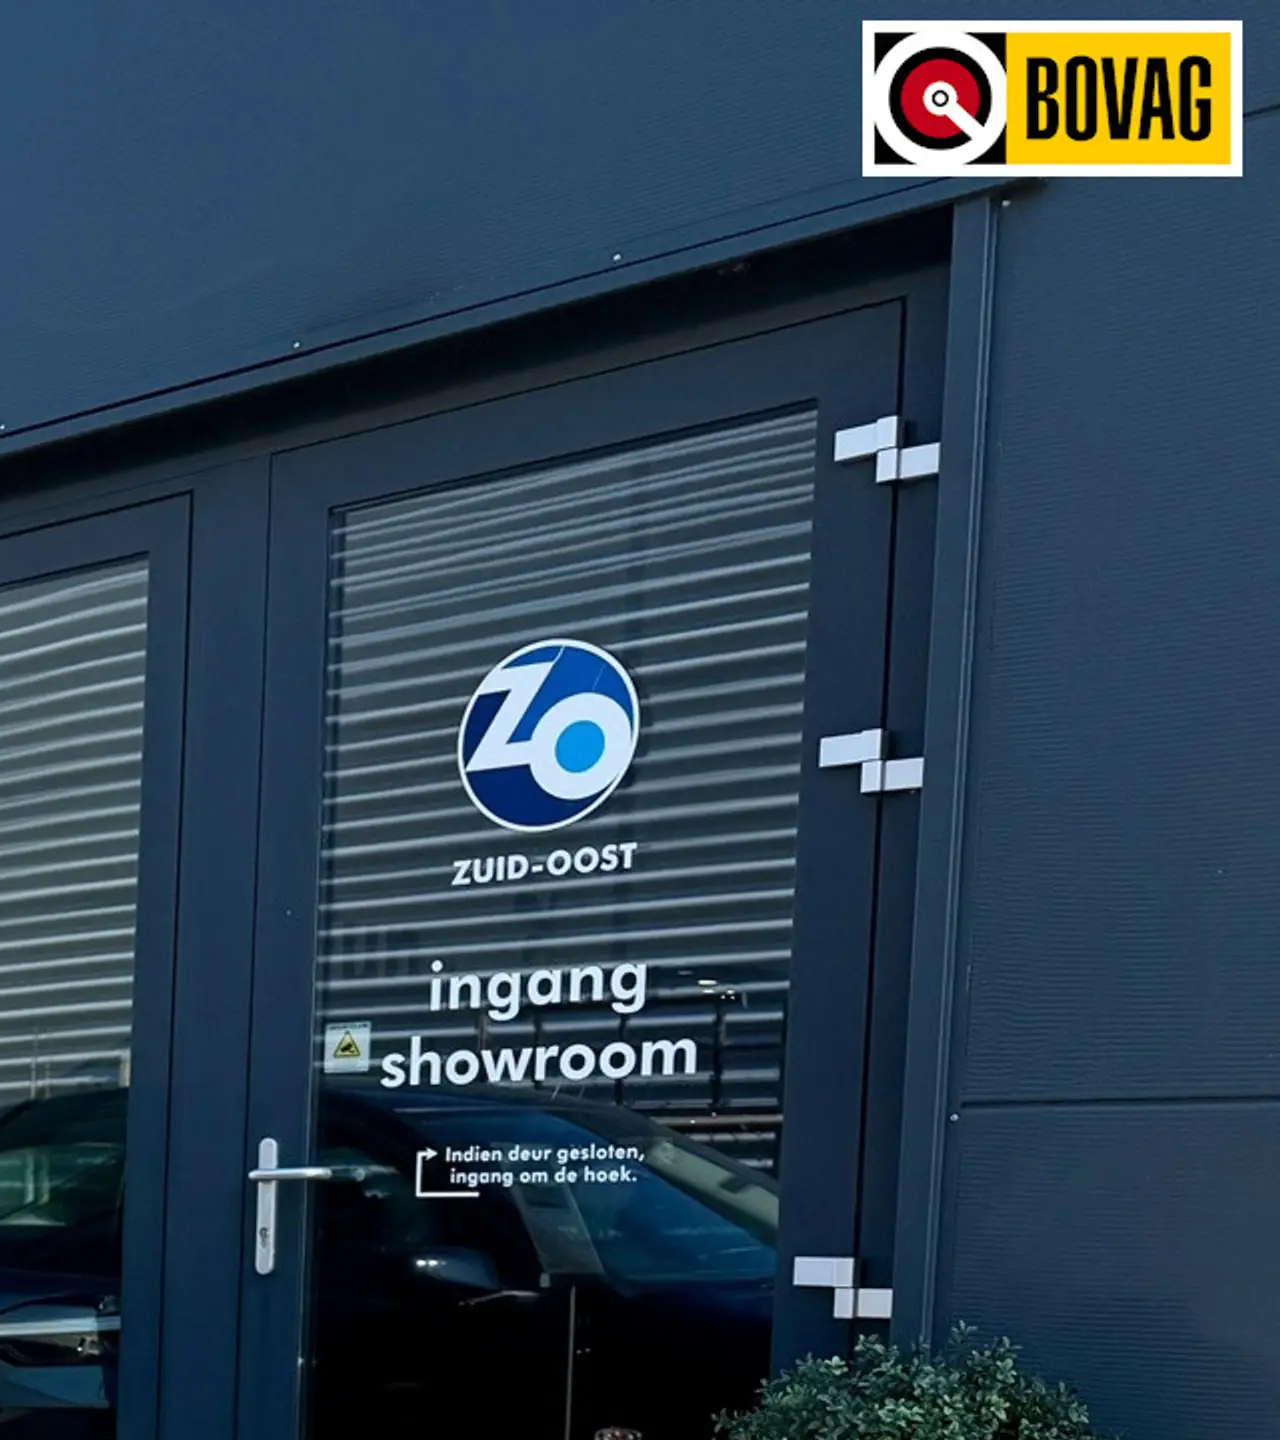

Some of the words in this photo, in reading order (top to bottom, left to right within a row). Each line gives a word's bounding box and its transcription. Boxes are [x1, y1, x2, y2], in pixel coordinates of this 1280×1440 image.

[450, 842, 638, 887] ZUID-OOST
[428, 960, 648, 1020] ingang
[380, 1036, 698, 1089] showroom
[444, 1145, 503, 1164] Indien
[507, 1145, 552, 1163] deur
[556, 1143, 646, 1167] gesloten,
[449, 1166, 513, 1188] ingang
[518, 1171, 550, 1185] om
[553, 1166, 578, 1184] de
[582, 1165, 638, 1184] hoek.
